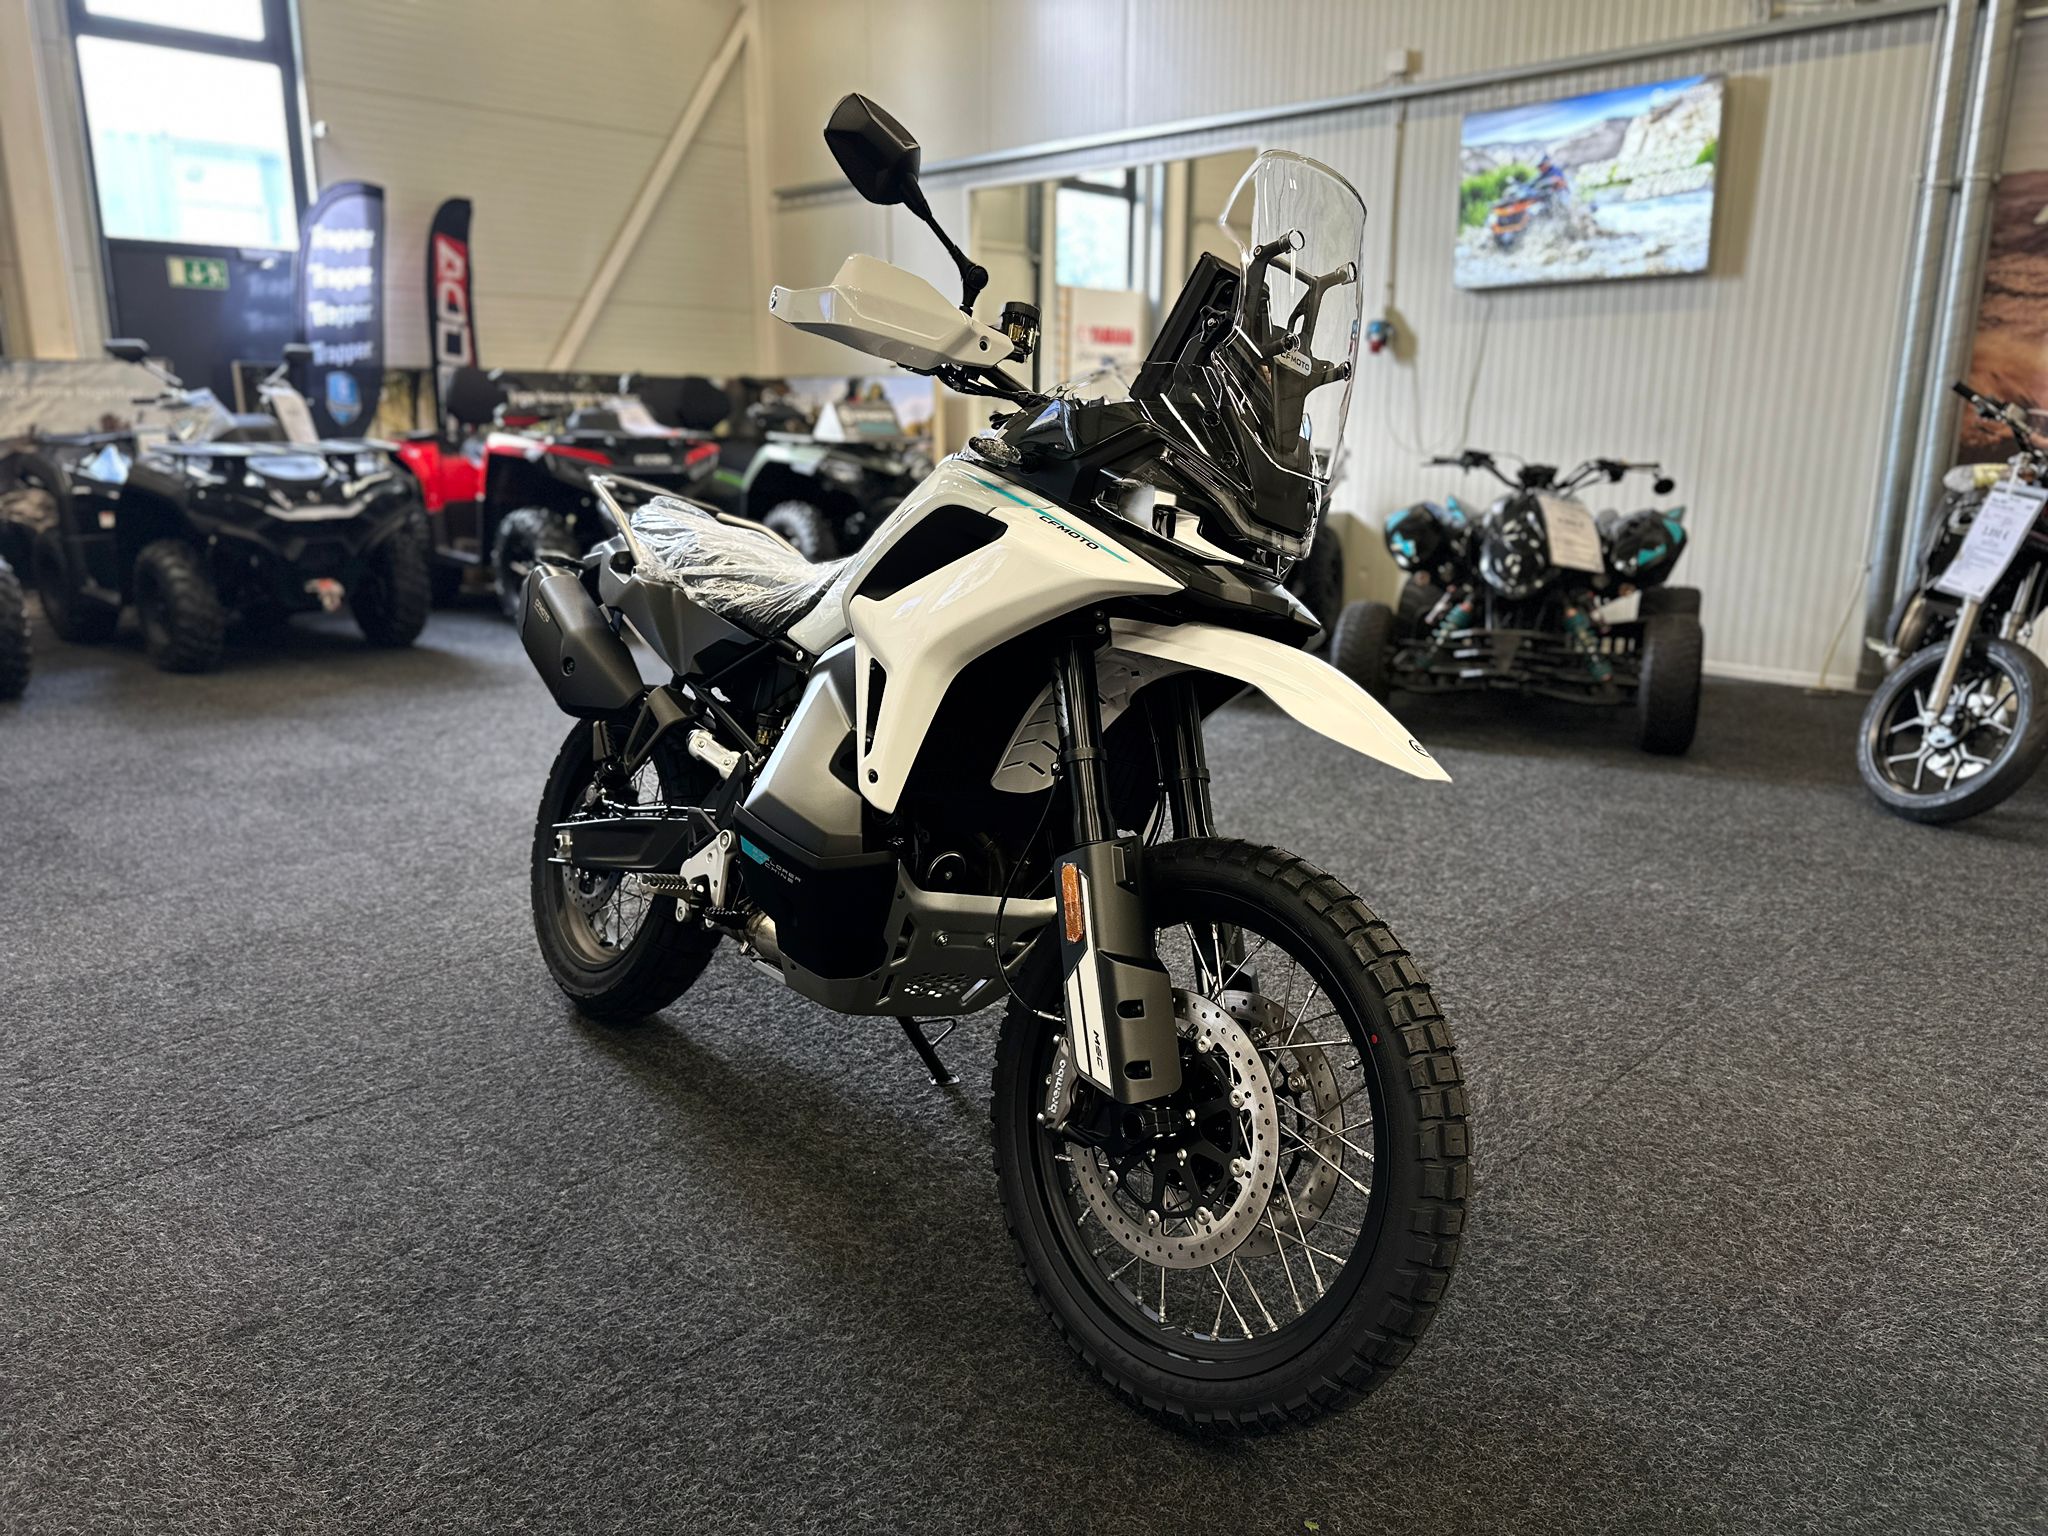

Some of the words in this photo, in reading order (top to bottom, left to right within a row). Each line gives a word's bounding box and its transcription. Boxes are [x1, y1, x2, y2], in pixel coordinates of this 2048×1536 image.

[1280, 352, 1310, 372] CFMOTO
[1038, 515, 1100, 550] CFMOTO
[1047, 1059, 1066, 1114] brembo
